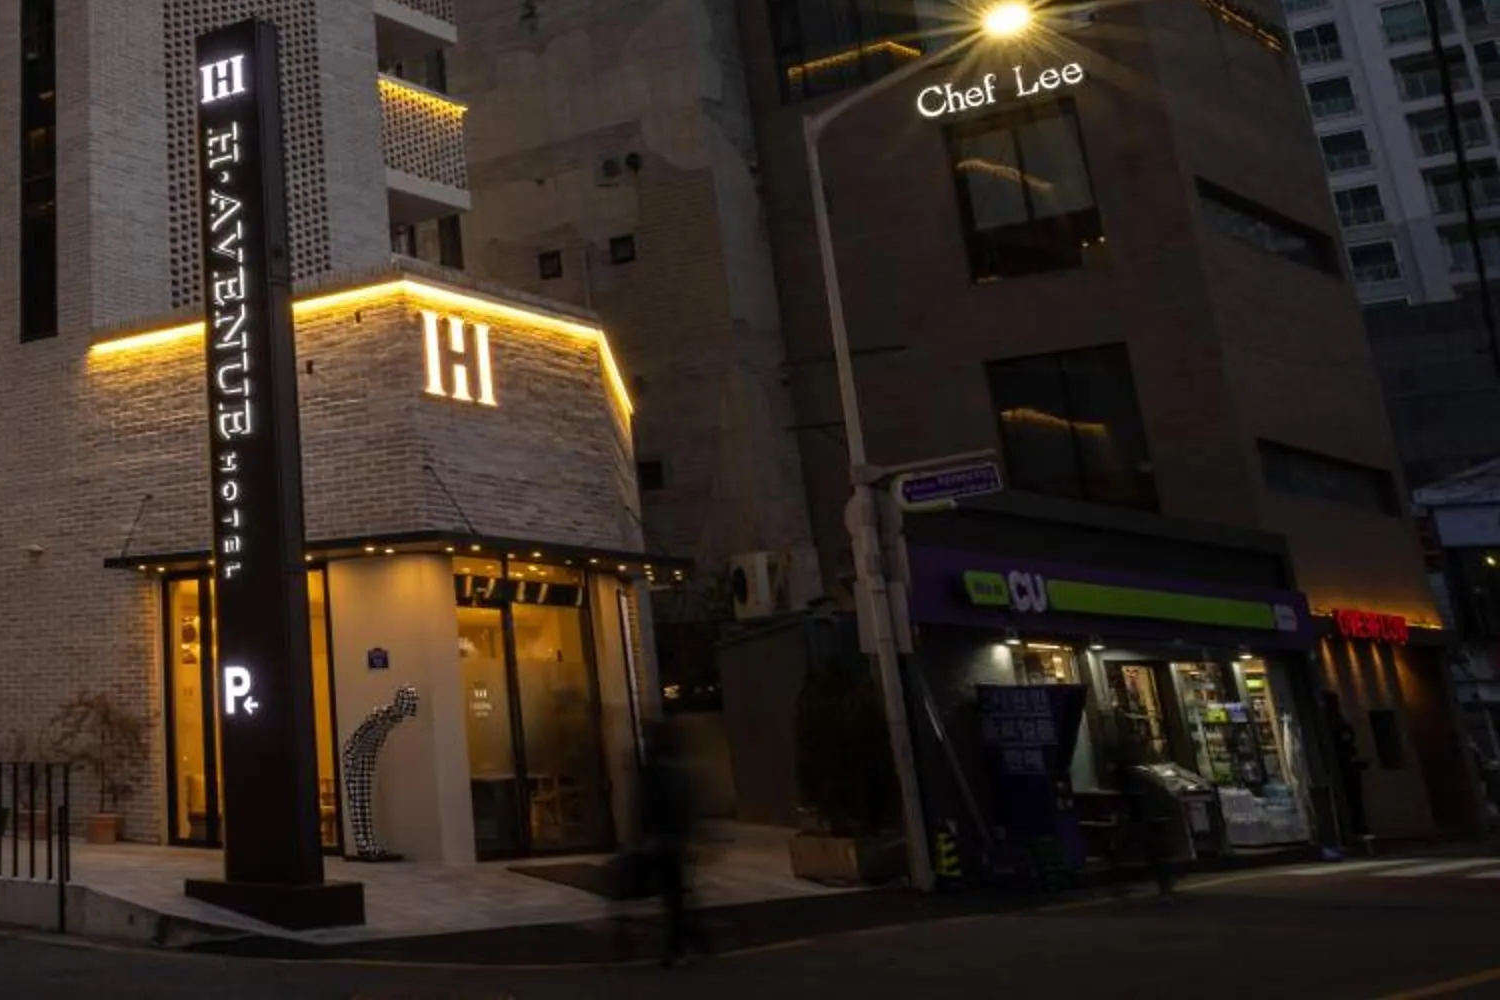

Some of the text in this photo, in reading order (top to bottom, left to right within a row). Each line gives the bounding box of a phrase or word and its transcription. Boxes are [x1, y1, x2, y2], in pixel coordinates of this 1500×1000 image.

[917, 61, 1084, 118] Chef Lee
[218, 450, 243, 580] HOTEL
